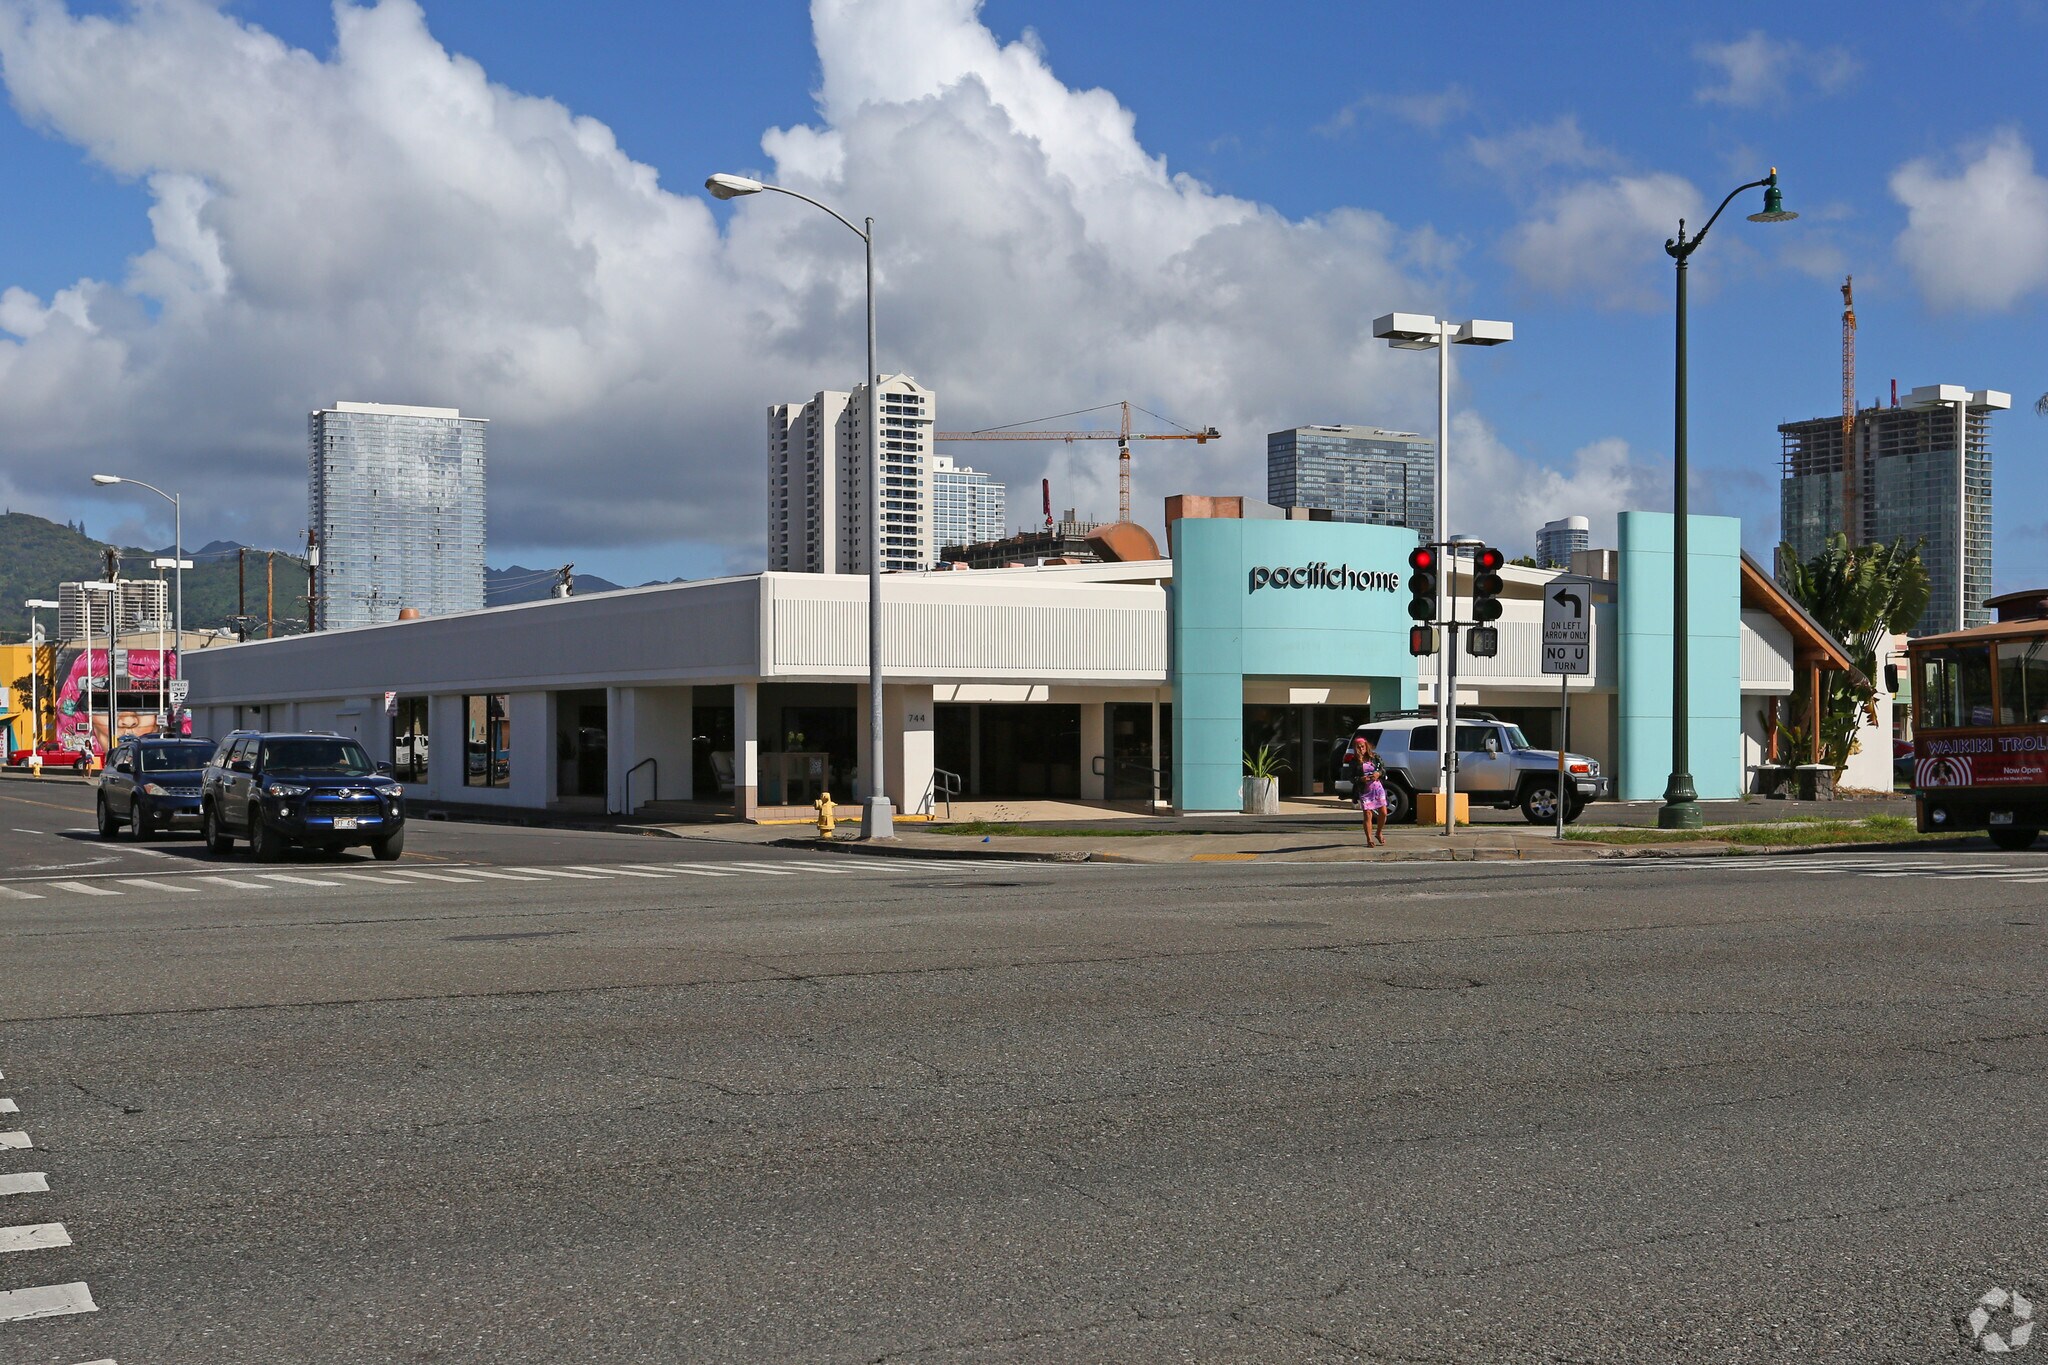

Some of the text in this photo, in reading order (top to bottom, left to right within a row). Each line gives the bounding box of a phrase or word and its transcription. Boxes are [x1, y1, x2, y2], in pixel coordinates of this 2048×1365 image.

[1249, 561, 1400, 595] pacifichome
[1551, 622, 1581, 630] ON LEFT
[1545, 631, 1587, 639] ARROW ONLY
[1547, 647, 1584, 659] NO U
[1554, 661, 1576, 670] TURN
[173, 692, 186, 701] 25
[908, 714, 925, 722] 744
[1927, 736, 2048, 755] WAIKIKI TROL
